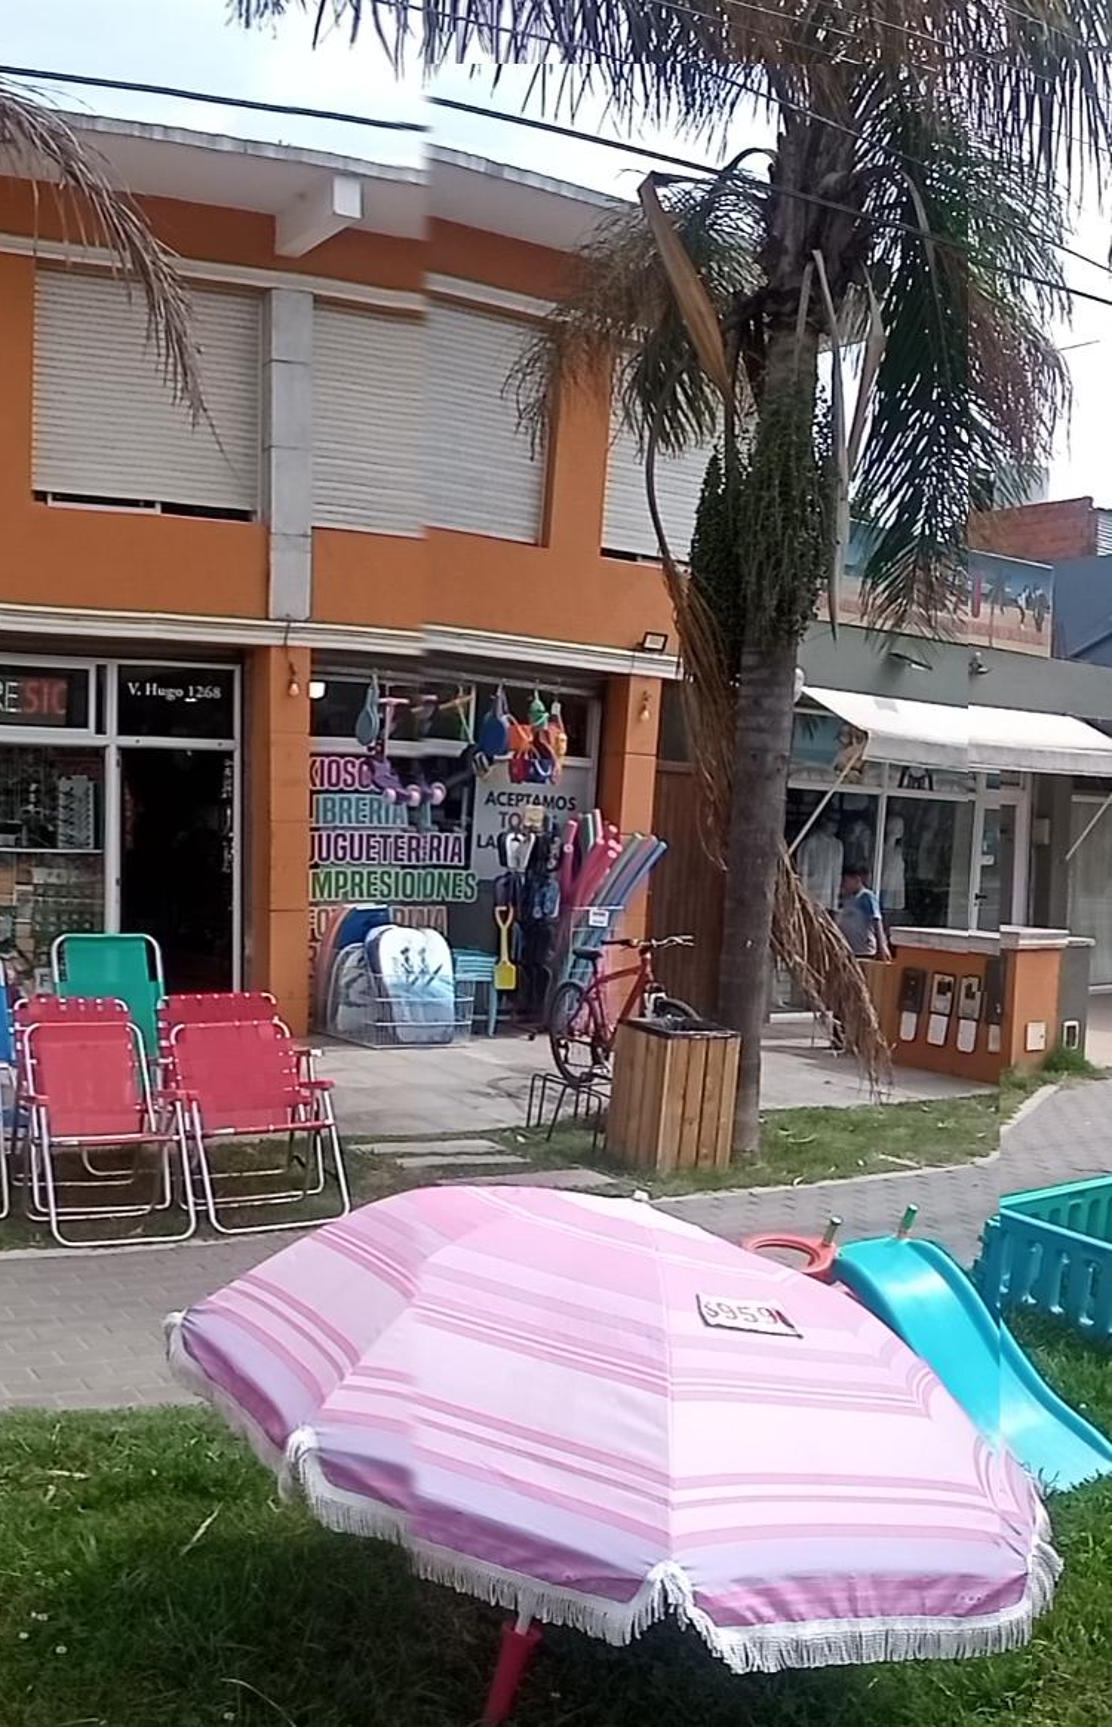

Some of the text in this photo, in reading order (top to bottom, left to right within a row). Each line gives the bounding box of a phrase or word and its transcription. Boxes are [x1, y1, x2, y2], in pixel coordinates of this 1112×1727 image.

[145, 682, 185, 701] Hugo
[188, 684, 222, 699] 1268
[484, 789, 577, 812] ACEPTAMOS
